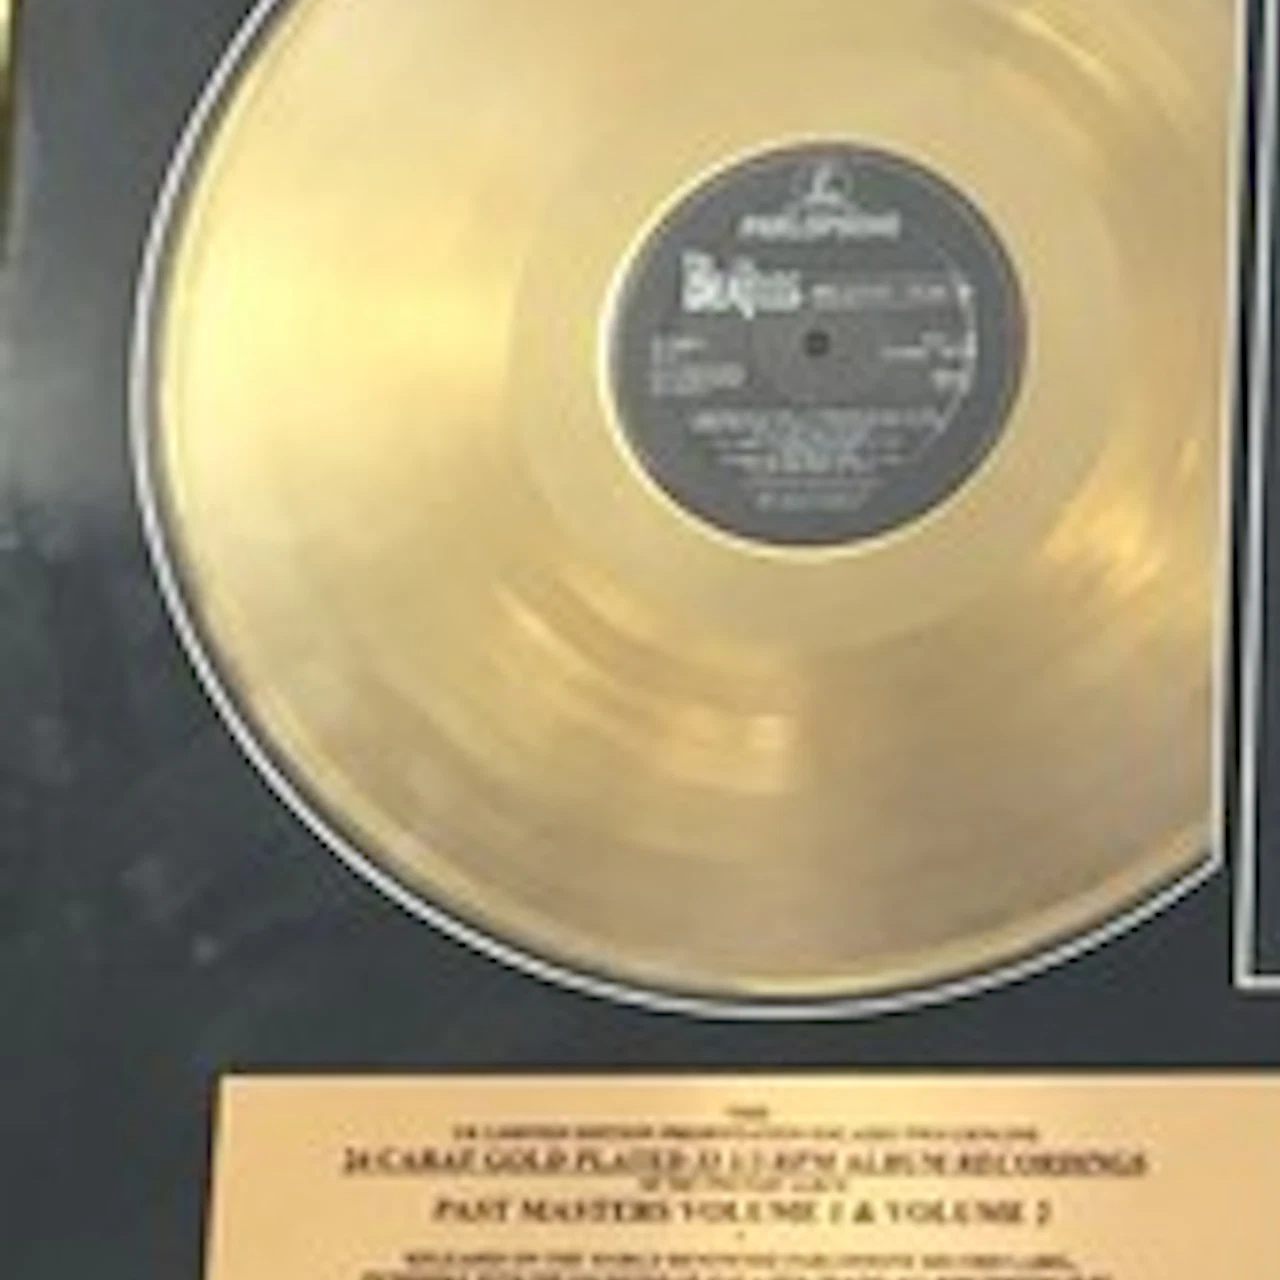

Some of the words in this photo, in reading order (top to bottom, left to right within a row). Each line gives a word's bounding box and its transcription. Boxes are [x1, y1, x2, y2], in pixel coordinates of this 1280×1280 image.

[431, 1199, 510, 1224] PAST
[520, 1200, 669, 1224] MASTERS
[677, 1200, 819, 1224] VOLUME
[884, 1201, 1025, 1225] VOLUME
